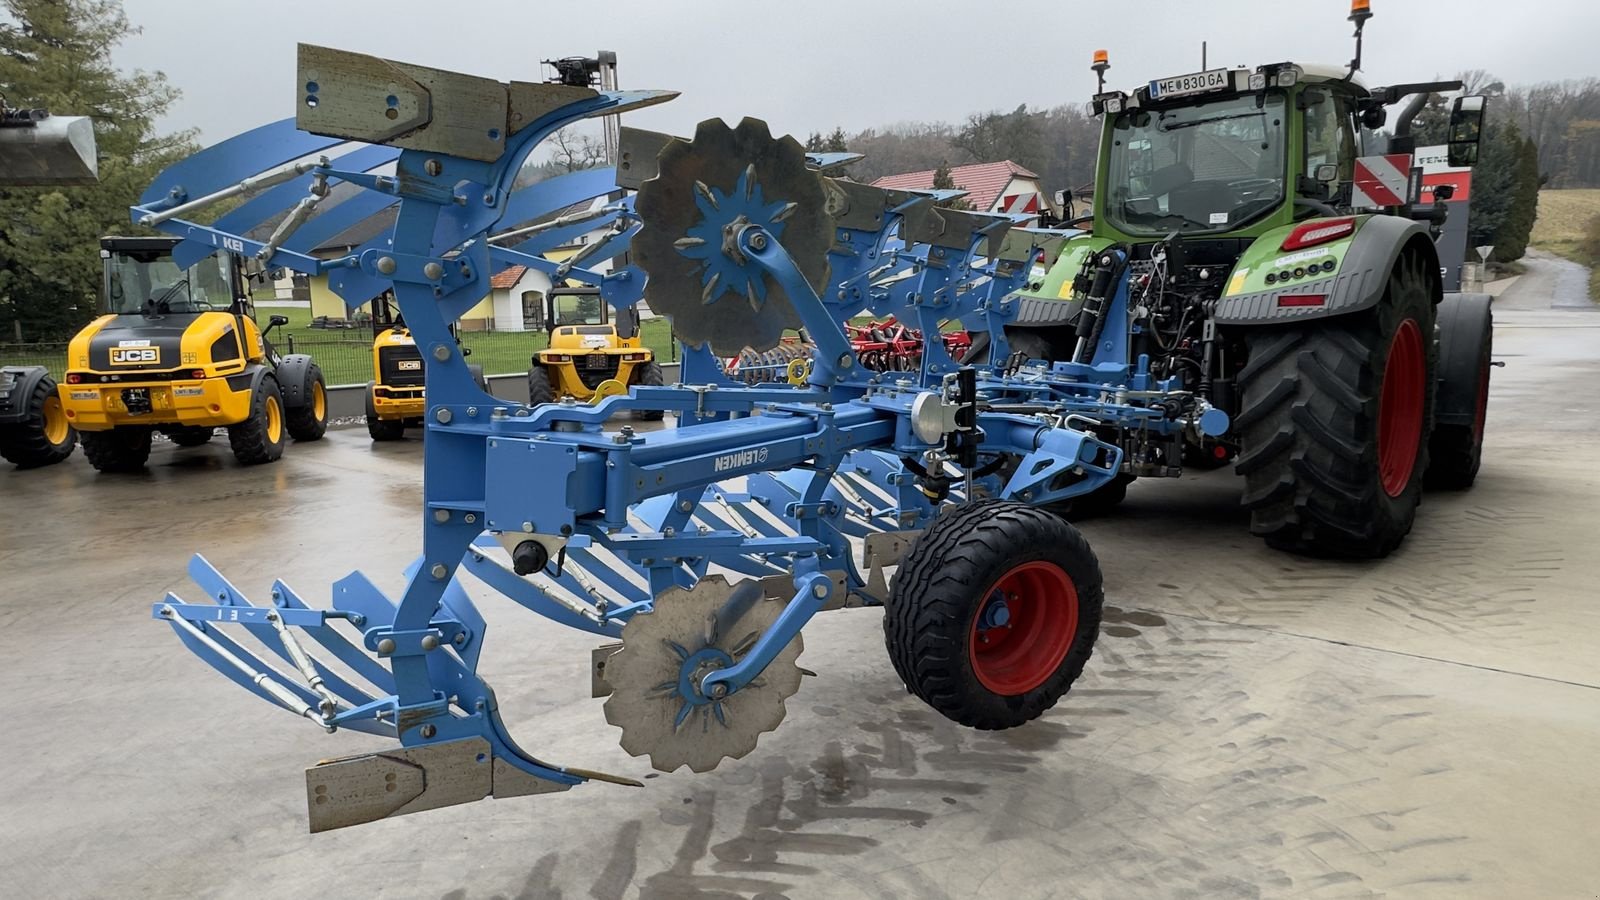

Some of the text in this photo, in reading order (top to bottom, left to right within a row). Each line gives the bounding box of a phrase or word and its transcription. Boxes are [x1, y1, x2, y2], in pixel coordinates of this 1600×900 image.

[1160, 73, 1224, 94] ME 830 GA
[113, 350, 156, 362] JCB
[714, 449, 759, 472] LEMKEN
